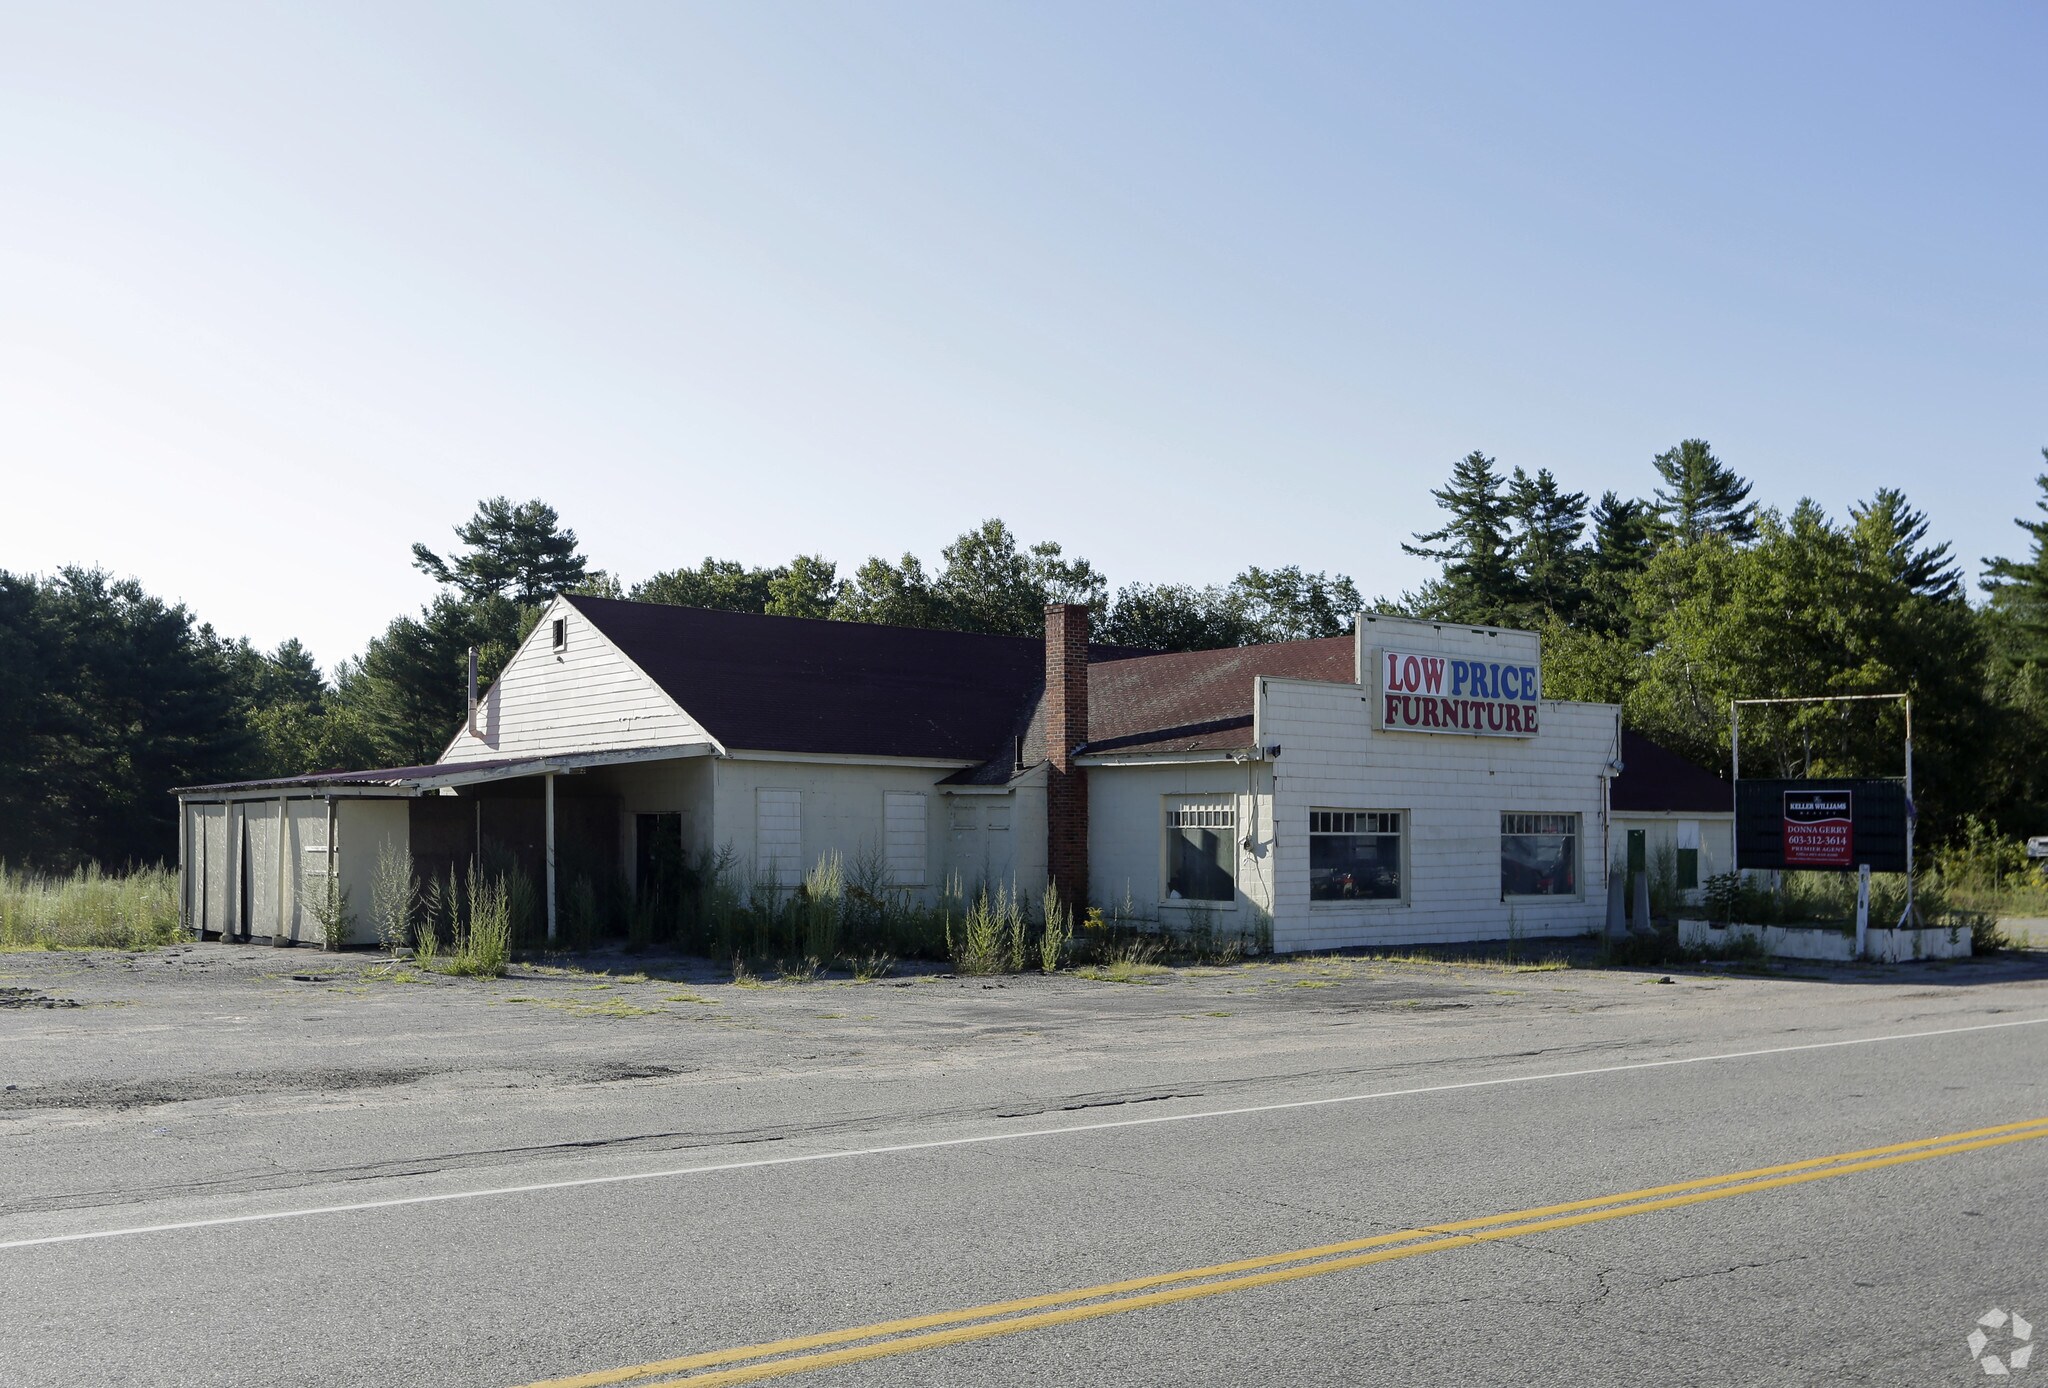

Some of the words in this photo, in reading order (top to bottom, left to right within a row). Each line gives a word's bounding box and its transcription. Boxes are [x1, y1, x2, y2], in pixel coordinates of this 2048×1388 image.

[1387, 653, 1445, 694] LOW
[1451, 660, 1537, 701] PRICE
[1385, 694, 1538, 733] FURNITURE
[1788, 835, 1847, 845] 603-312-3614
[1819, 826, 1848, 834] GERRY
